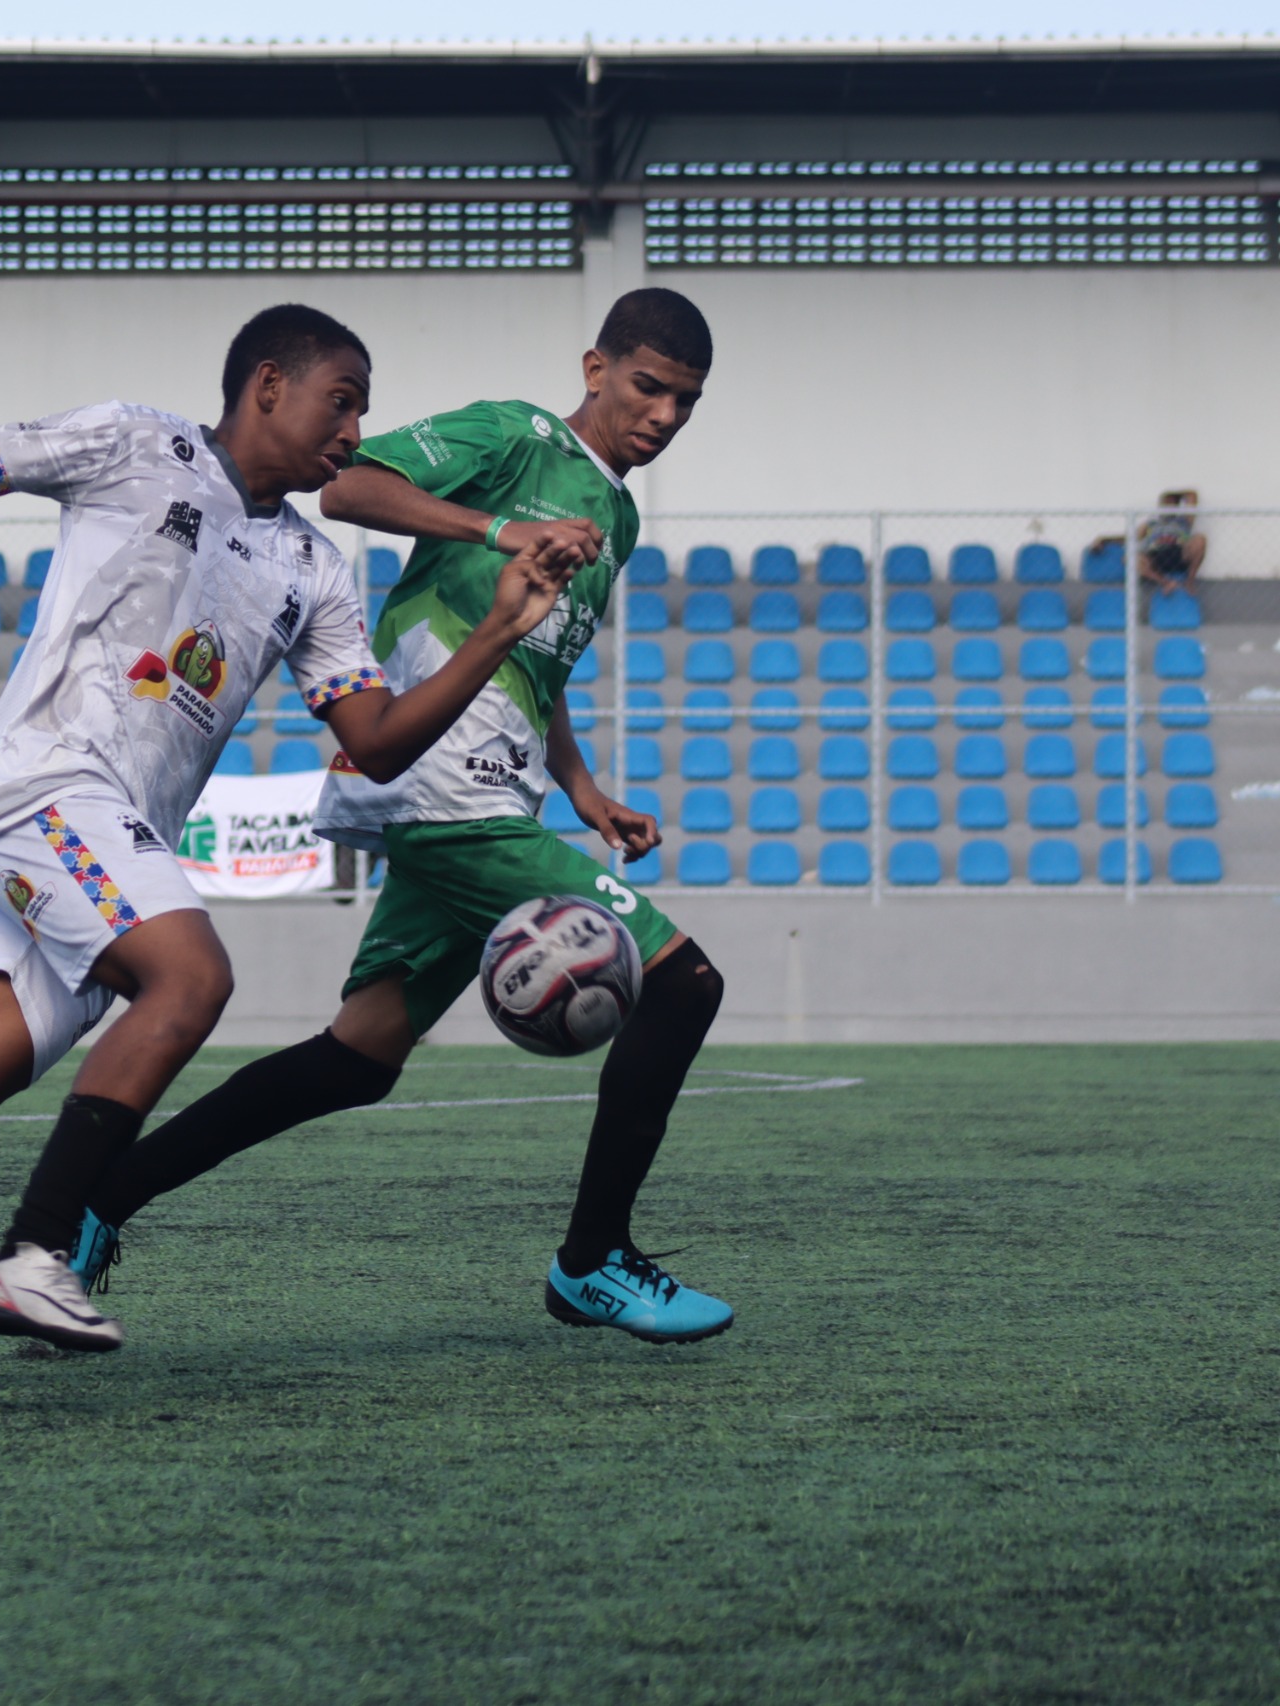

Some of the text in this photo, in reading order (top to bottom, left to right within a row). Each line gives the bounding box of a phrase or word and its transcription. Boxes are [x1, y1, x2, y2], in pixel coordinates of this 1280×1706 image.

[514, 503, 527, 514] DA
[169, 694, 215, 735] PREMIADO
[176, 685, 216, 721] PARAÍBA
[595, 874, 637, 915] 3
